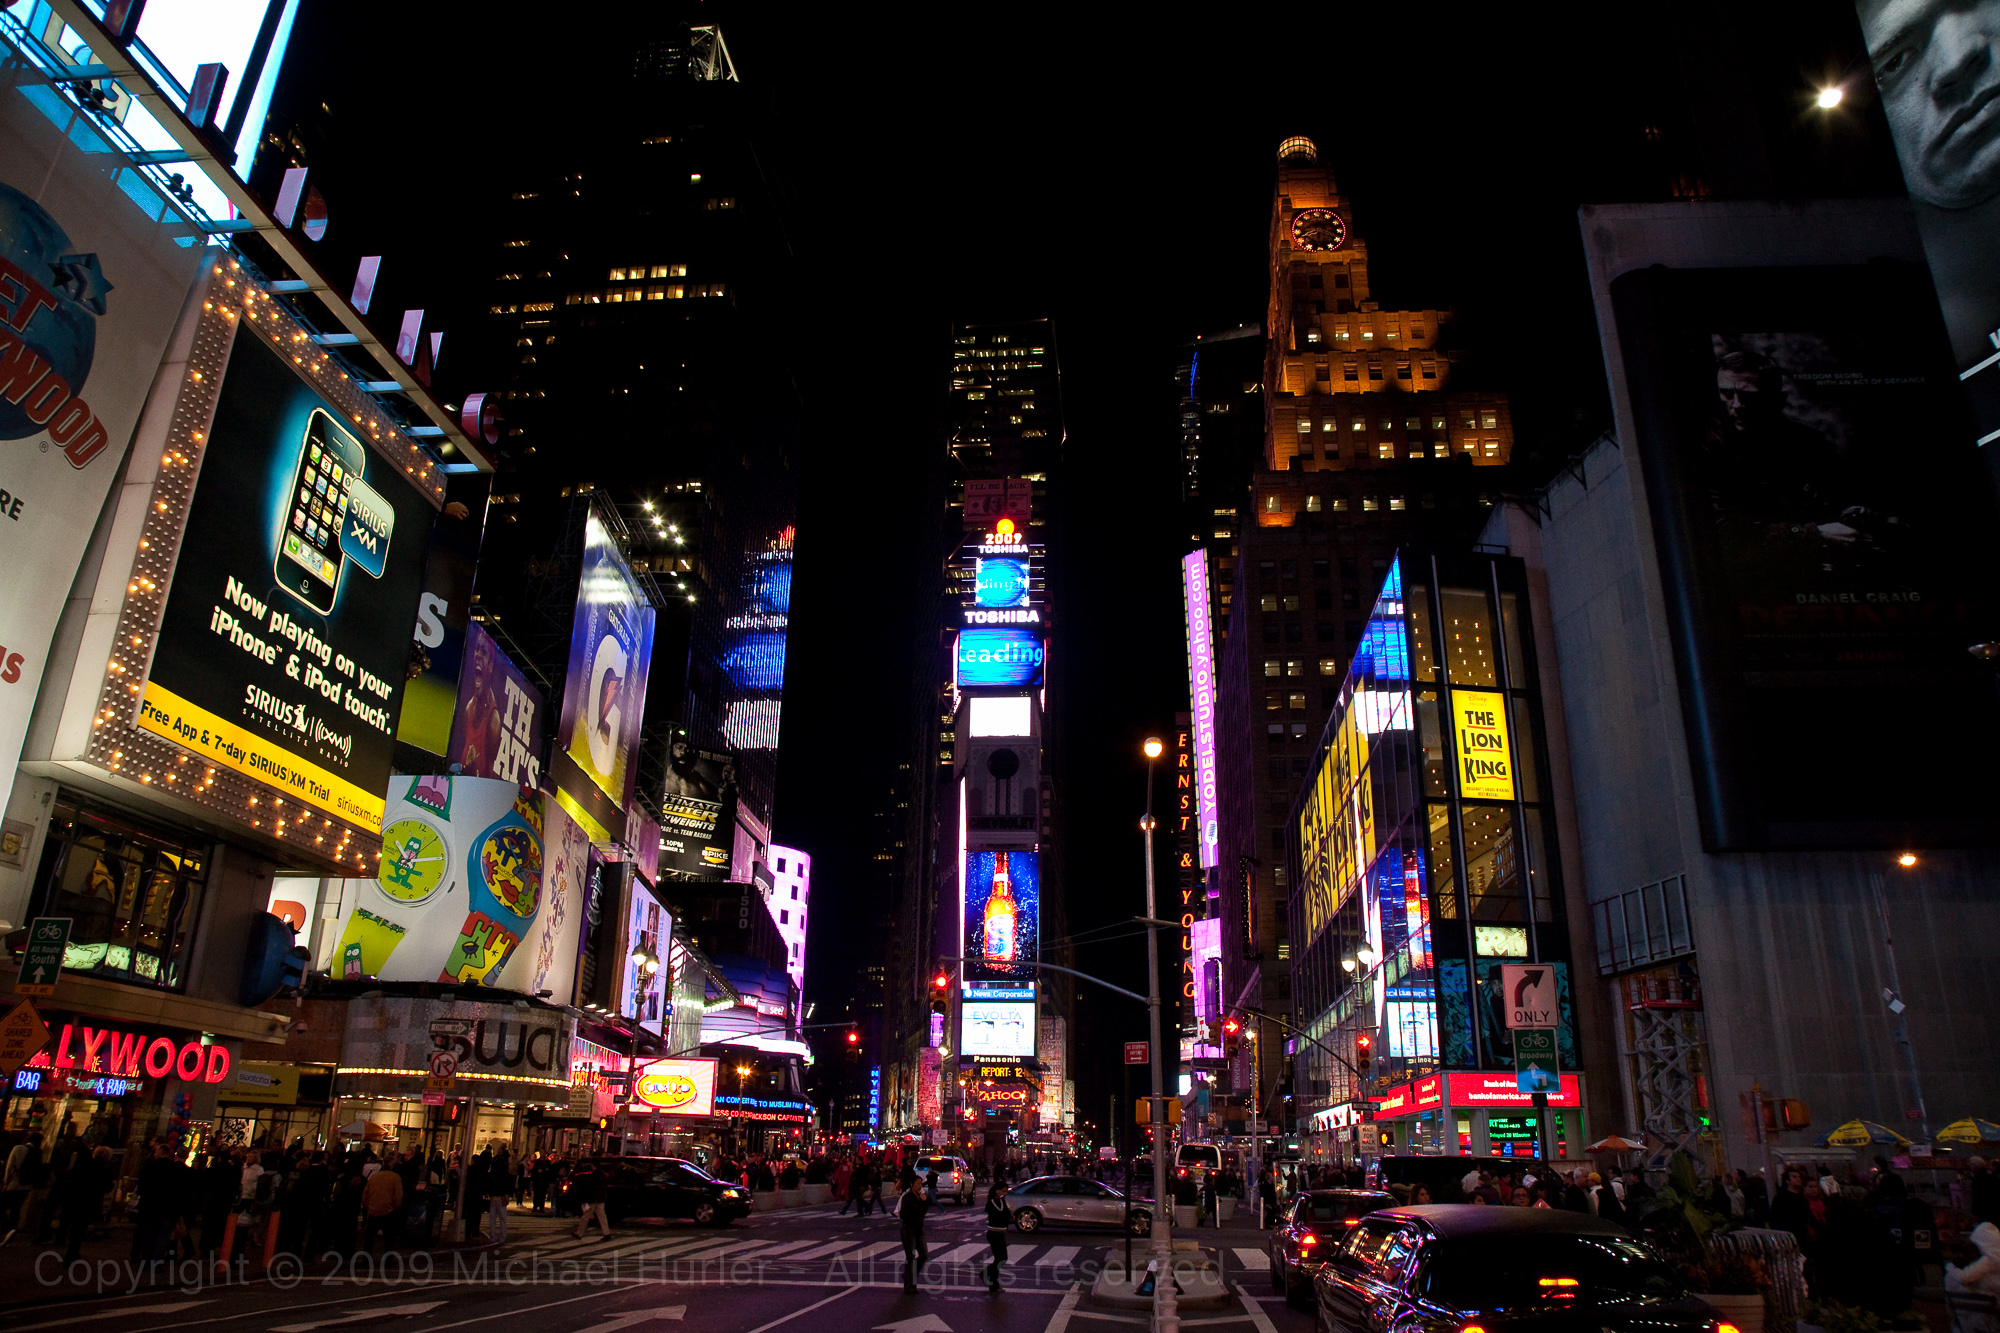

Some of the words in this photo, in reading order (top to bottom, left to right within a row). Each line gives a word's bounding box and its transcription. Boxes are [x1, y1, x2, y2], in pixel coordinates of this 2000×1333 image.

[351, 497, 387, 538] SIRIUS
[351, 520, 377, 554] XM
[985, 533, 1023, 544] 2009
[978, 544, 1029, 554] TOSHIBA
[1795, 593, 1860, 604] DANIEL
[1866, 591, 1921, 603] CRAIG
[965, 610, 1039, 624] TOSHIBA
[608, 609, 631, 650] GATORADE
[225, 575, 267, 620] Now
[269, 611, 332, 667] playing
[335, 653, 355, 678] on
[358, 666, 392, 700] your
[285, 654, 300, 681] &
[304, 663, 342, 704] iPod
[1190, 562, 1217, 814] YODELSTUDIO.yahoo.com
[245, 684, 294, 726] SIRIUS
[1464, 710, 1495, 726] THE
[140, 699, 169, 726] Free
[172, 717, 197, 741] App
[200, 730, 210, 746] &
[215, 735, 246, 764] 7-day
[309, 780, 331, 802] Trial
[699, 750, 711, 760] THE
[712, 752, 733, 763] HOUSE
[1178, 733, 1190, 831] ERNST
[969, 817, 1036, 830] CHEVROLET
[701, 850, 729, 860] SPIKE
[1180, 853, 1193, 868] &
[739, 885, 749, 929] 1500
[42, 946, 60, 954] Route
[1181, 890, 1195, 998] YOUNG
[30, 955, 56, 965] South
[993, 990, 1033, 999] Corporation
[973, 1011, 1022, 1020] EVOLTA
[1514, 1011, 1549, 1022] ONLY
[5, 1028, 33, 1037] SHARED
[0, 1050, 25, 1059] AHEAD
[974, 1055, 1021, 1063] Panasonic
[1520, 1052, 1553, 1060] Broadway
[16, 1071, 41, 1091] BAR
[240, 1073, 262, 1083] swatch
[96, 1078, 105, 1094] &
[106, 1079, 126, 1096] BAR
